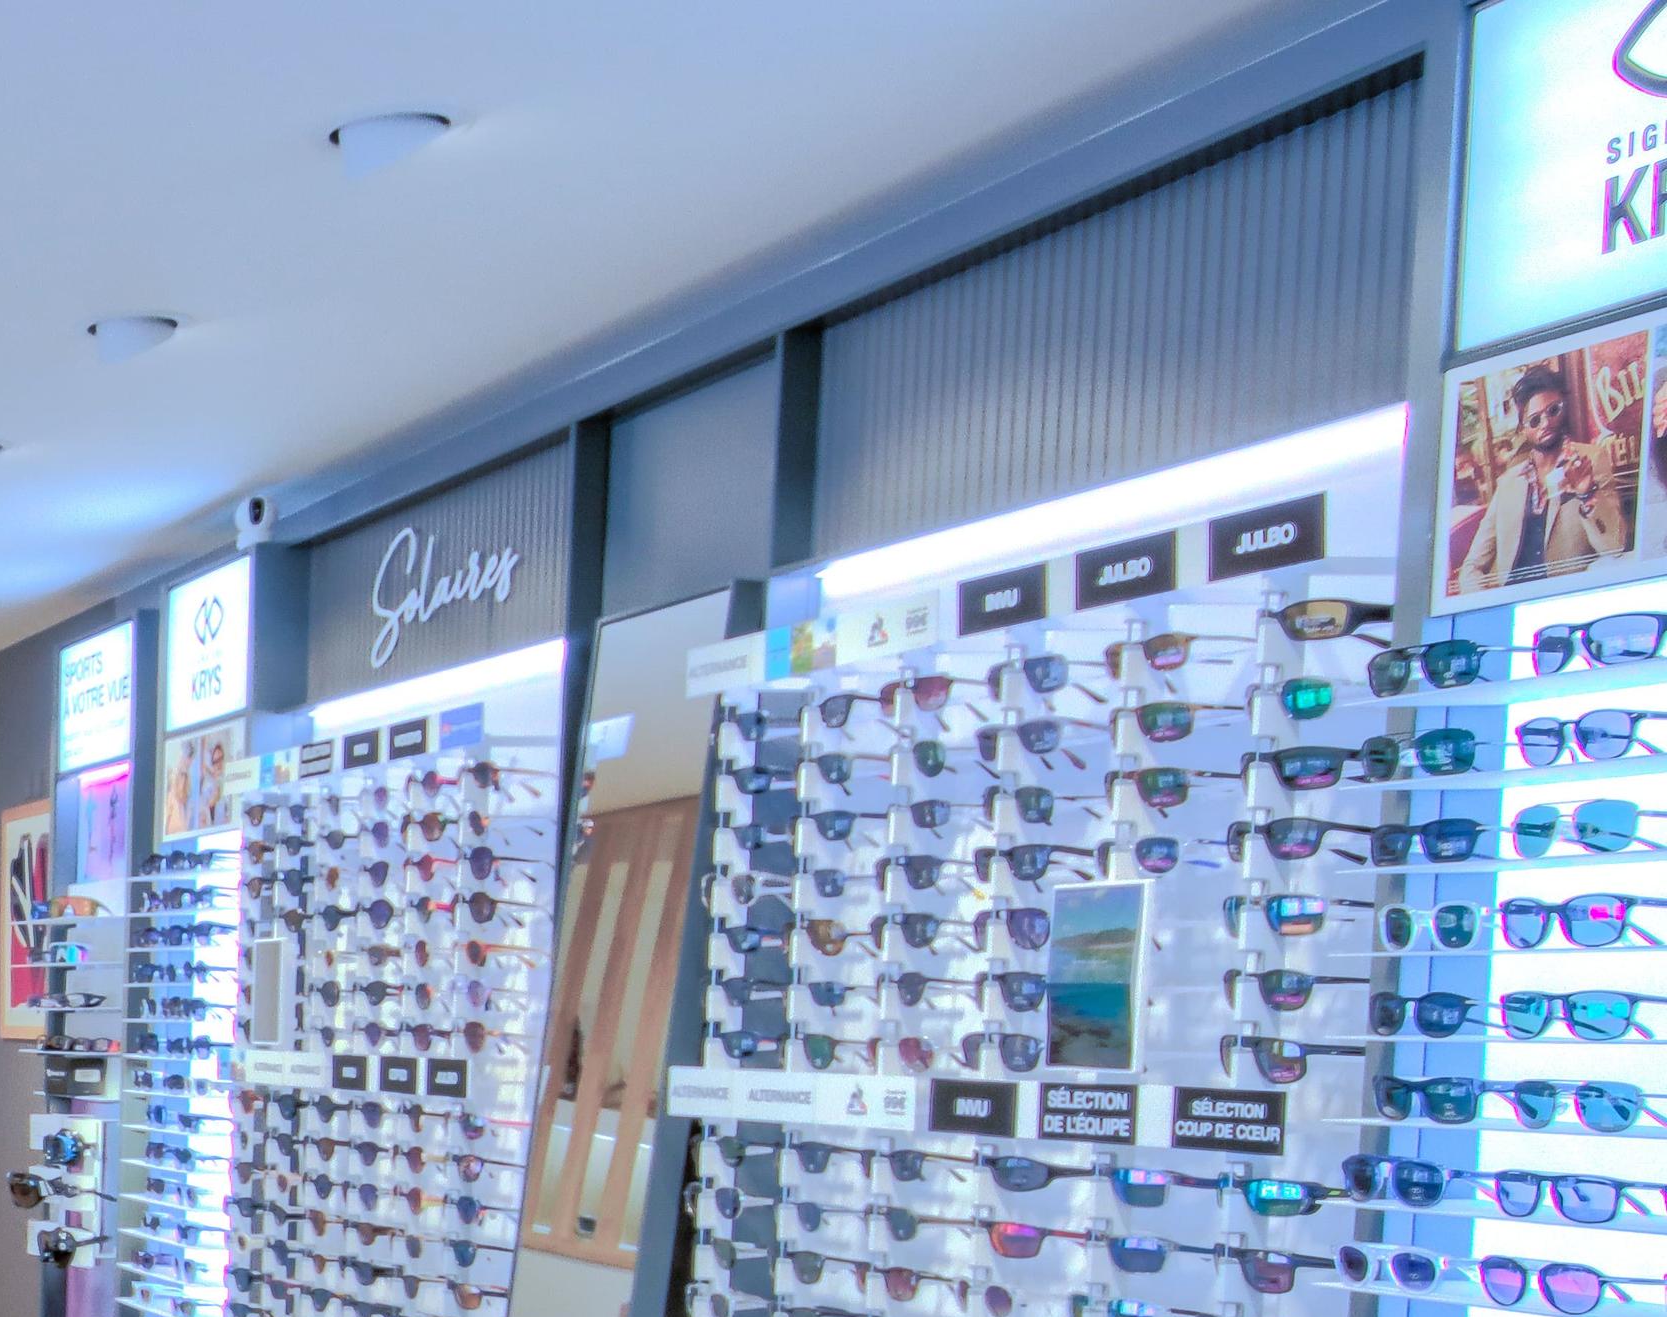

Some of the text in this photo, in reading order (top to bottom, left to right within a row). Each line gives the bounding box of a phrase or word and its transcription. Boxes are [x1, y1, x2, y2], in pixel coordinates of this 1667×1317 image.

[1607, 119, 1667, 164] SIG
[1236, 522, 1297, 554] JULBO
[1094, 556, 1154, 586] JULBO
[370, 527, 520, 668] Solaires
[64, 651, 103, 686] SPORTS
[192, 663, 222, 701] KRYS
[72, 683, 105, 714] VOTRE
[107, 675, 130, 703] VUE
[954, 1097, 990, 1119] INVU
[1047, 1086, 1130, 1111] SÉLECTION
[1191, 1096, 1265, 1119] SÉLECTION
[1043, 1111, 1131, 1137] DE L'ÉQUIPE
[1175, 1120, 1281, 1145] COUP DE CŒUR
